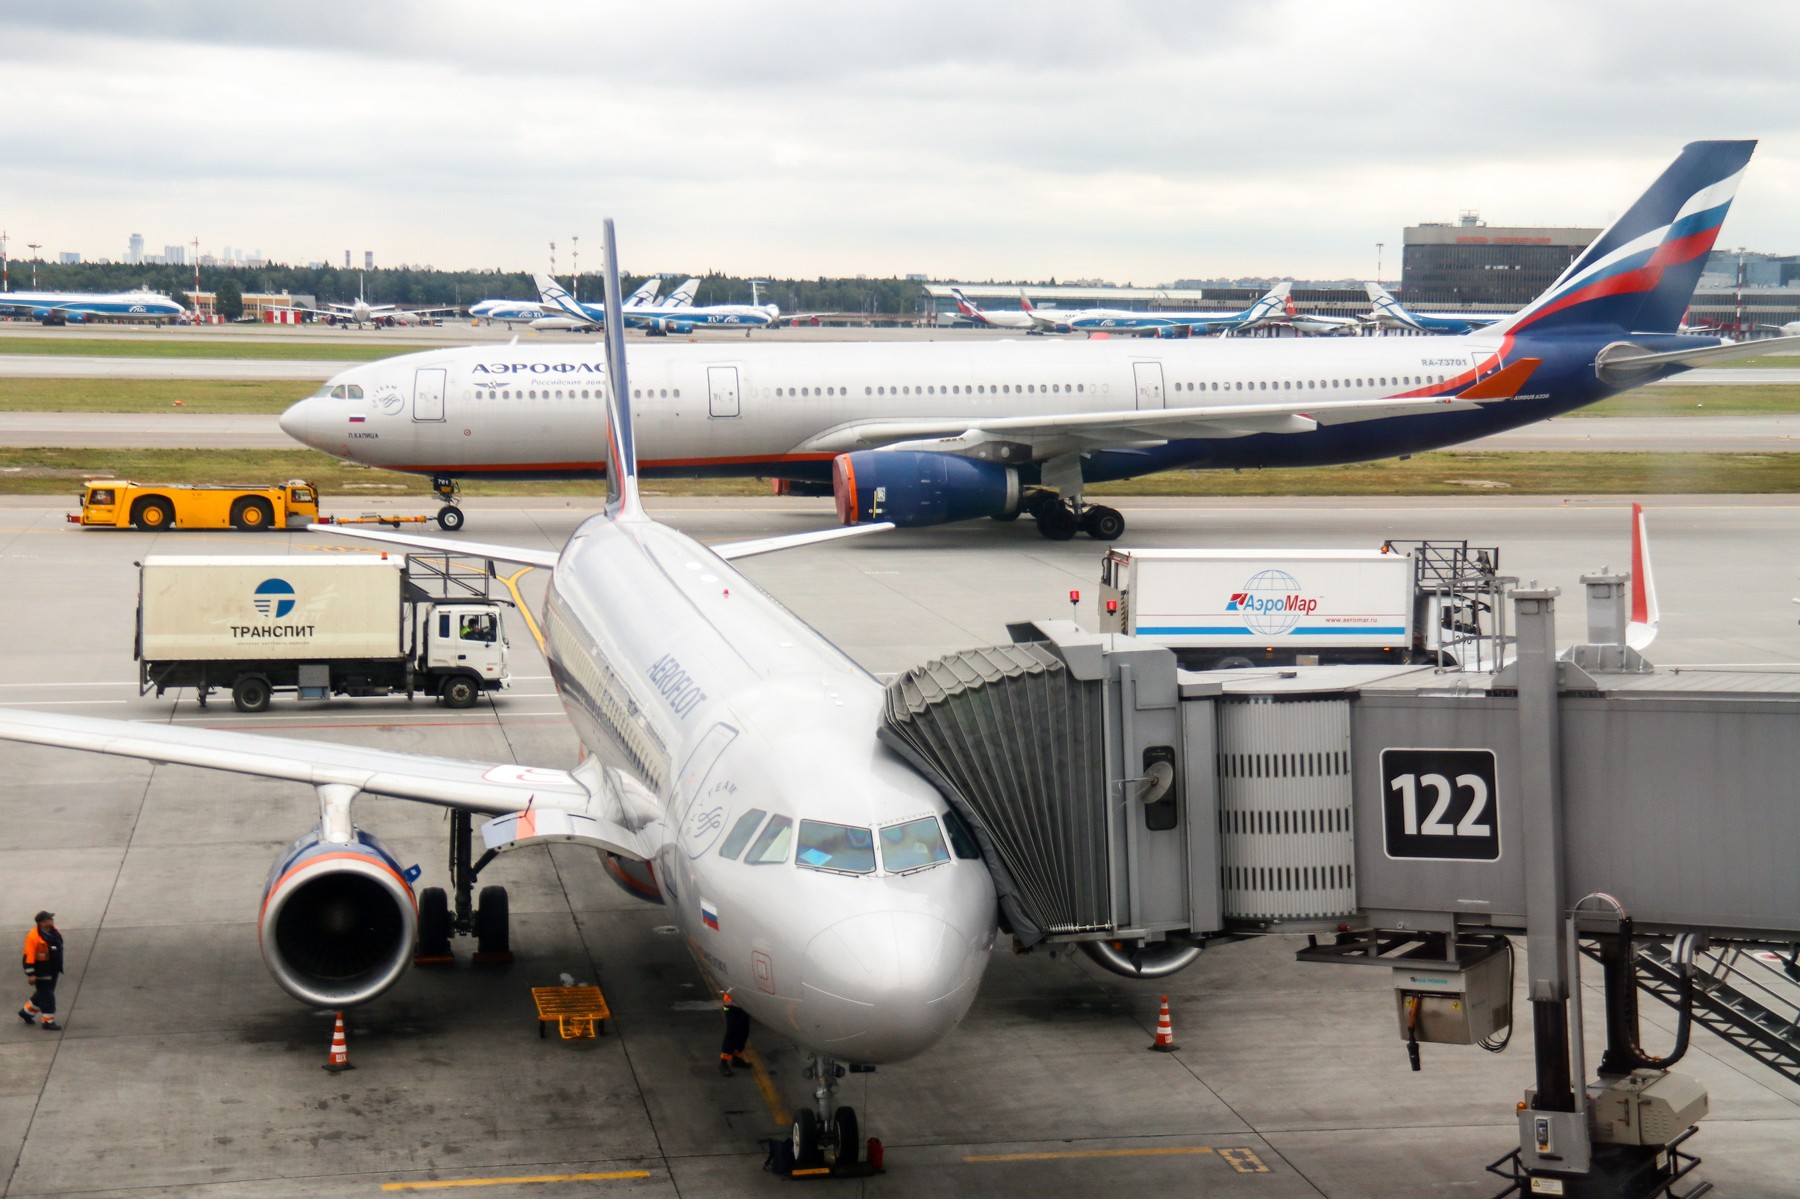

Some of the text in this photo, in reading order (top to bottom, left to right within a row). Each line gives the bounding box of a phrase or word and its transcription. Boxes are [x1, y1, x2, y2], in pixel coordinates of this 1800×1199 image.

[472, 363, 605, 374] АЭРОФЛО
[1243, 594, 1317, 615] АэроМар
[230, 625, 315, 638] ТРАНСПИТ
[646, 652, 708, 720] AEROFLOT
[1390, 773, 1491, 837] 122
